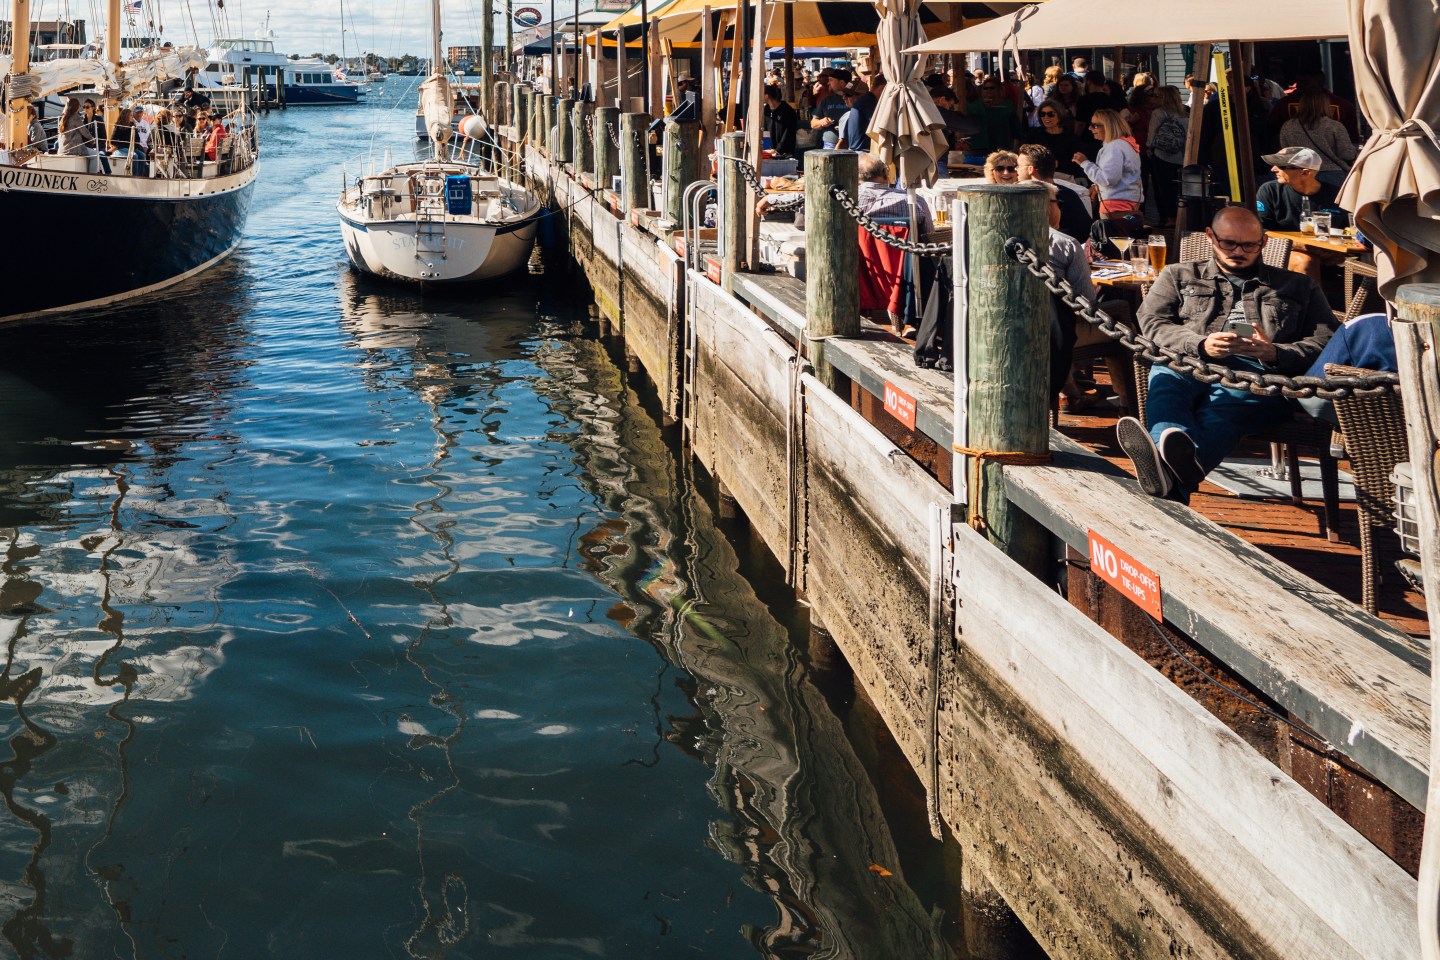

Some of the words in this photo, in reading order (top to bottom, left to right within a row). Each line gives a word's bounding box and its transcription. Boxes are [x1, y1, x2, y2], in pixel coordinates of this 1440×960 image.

[885, 386, 898, 411] NO
[1091, 538, 1118, 579] NO
[1120, 558, 1157, 593] DROP-OFFS
[1120, 574, 1146, 601] TIE-UPS
